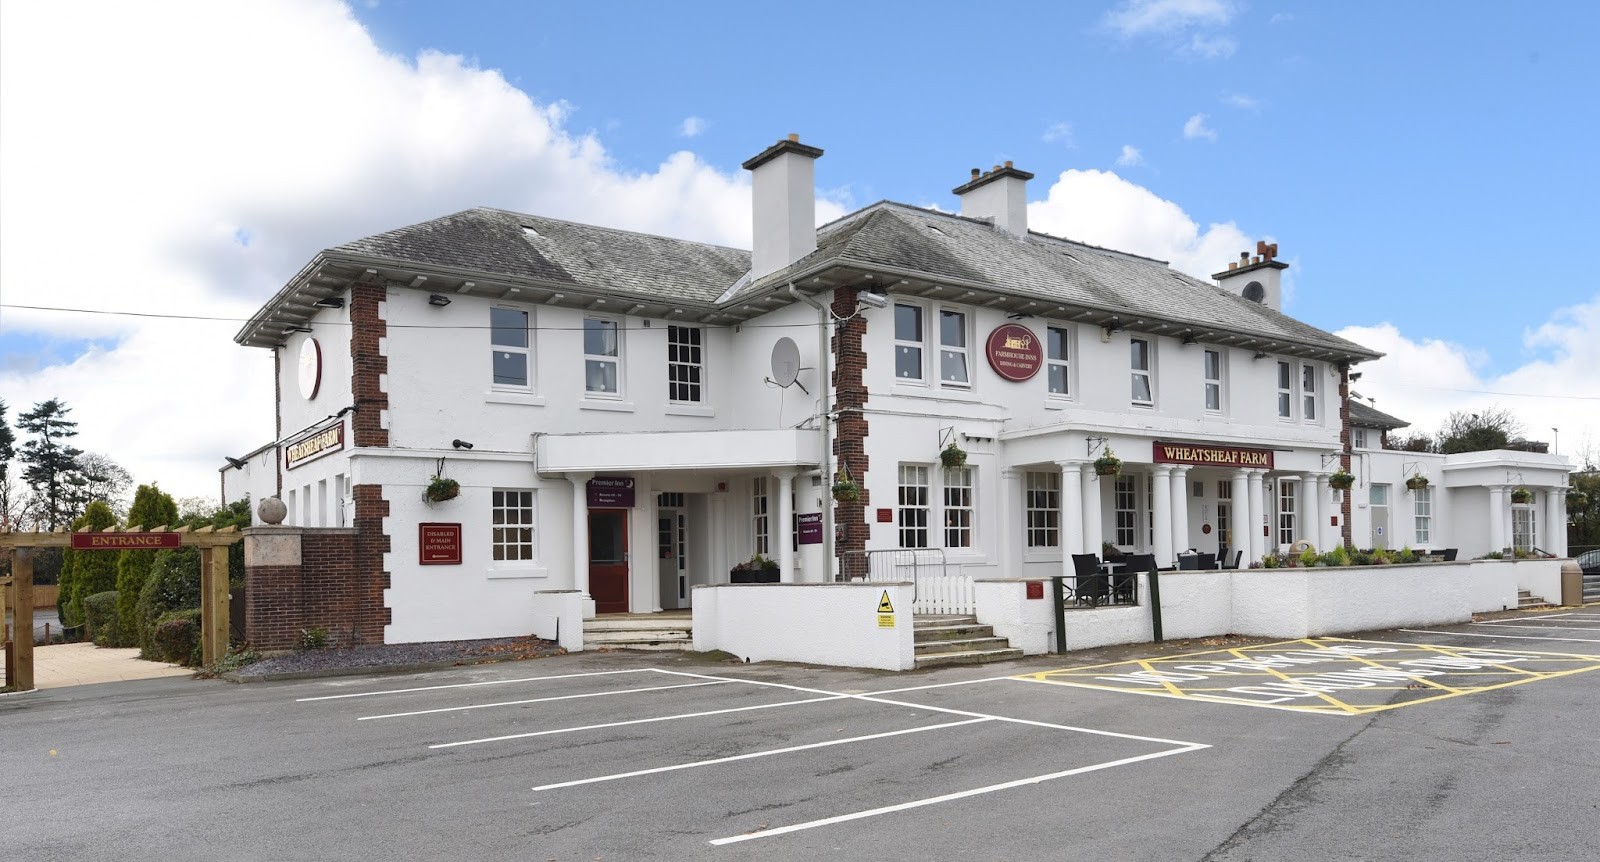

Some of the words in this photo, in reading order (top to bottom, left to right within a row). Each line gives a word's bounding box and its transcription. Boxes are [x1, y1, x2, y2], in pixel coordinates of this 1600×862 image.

[995, 351, 1025, 360] FARMHOUSE
[1025, 354, 1037, 362] INNS
[287, 436, 322, 464] WHEATSHEAF
[322, 428, 339, 448] FARM
[1163, 446, 1239, 464] WHEATSHEAF
[1240, 451, 1268, 465] FARM
[592, 479, 614, 487] Premier
[92, 536, 162, 546] ENTRANCE
[1094, 669, 1211, 686] NO
[1173, 645, 1399, 675] PARKING
[1189, 666, 1447, 704] LOADING
[1398, 651, 1542, 671] ONLY
